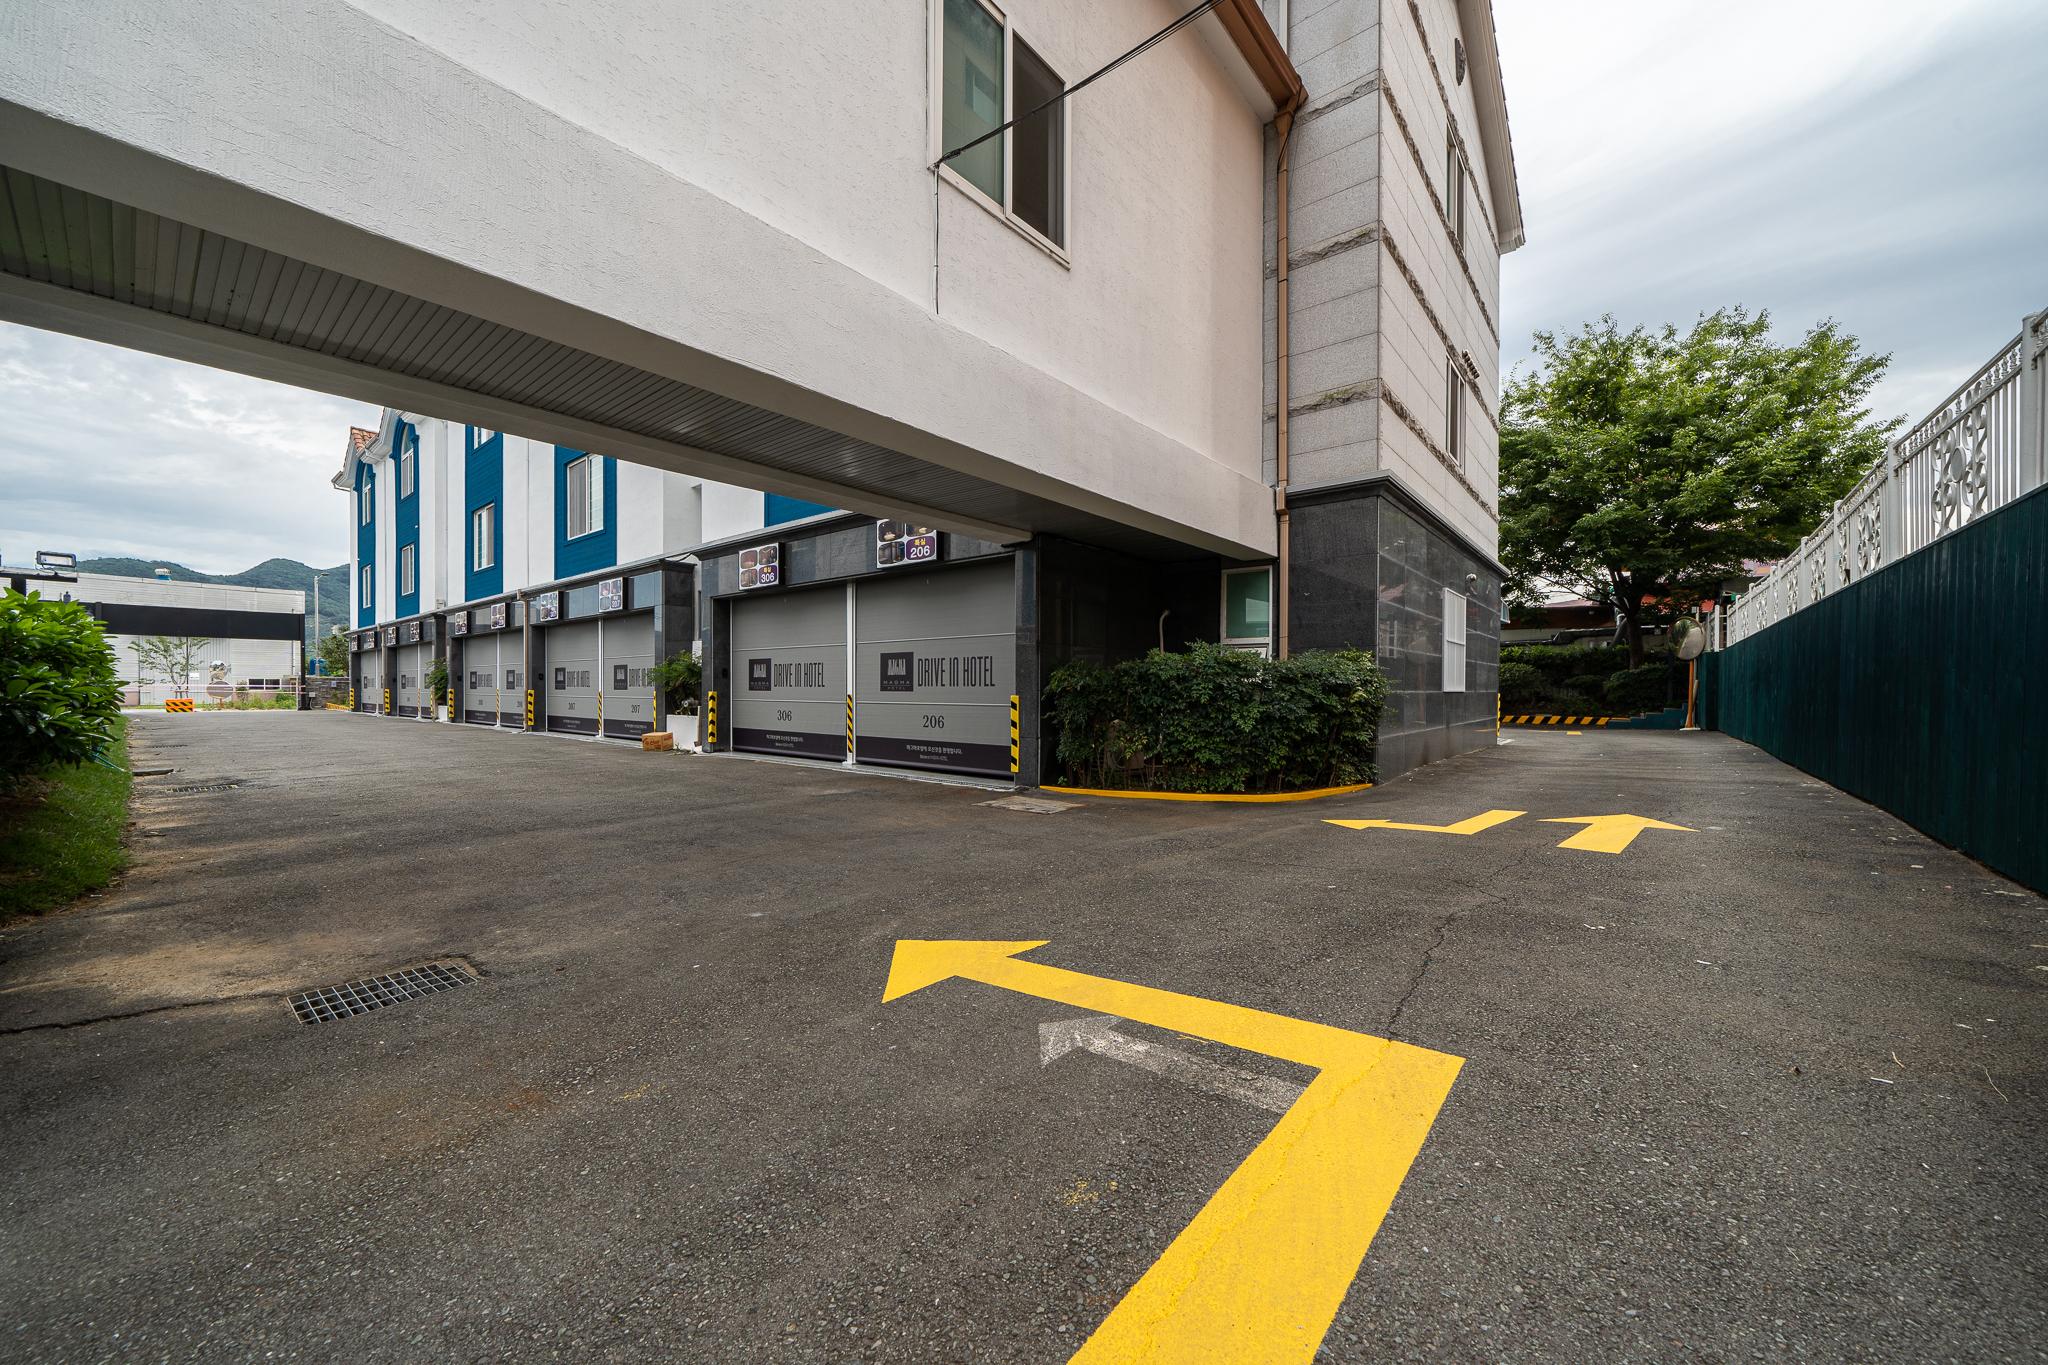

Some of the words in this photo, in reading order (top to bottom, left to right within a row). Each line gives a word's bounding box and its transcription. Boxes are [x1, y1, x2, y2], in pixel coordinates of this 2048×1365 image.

[911, 545, 930, 558] 206
[761, 573, 775, 583] 306
[774, 664, 793, 688] DRIVE
[804, 662, 825, 688] HOTEL
[918, 658, 945, 688] DRIVE
[949, 657, 959, 688] IN
[963, 656, 996, 688] HOTEL
[631, 704, 641, 714] 207
[777, 710, 792, 722] 306
[923, 714, 945, 729] 206
